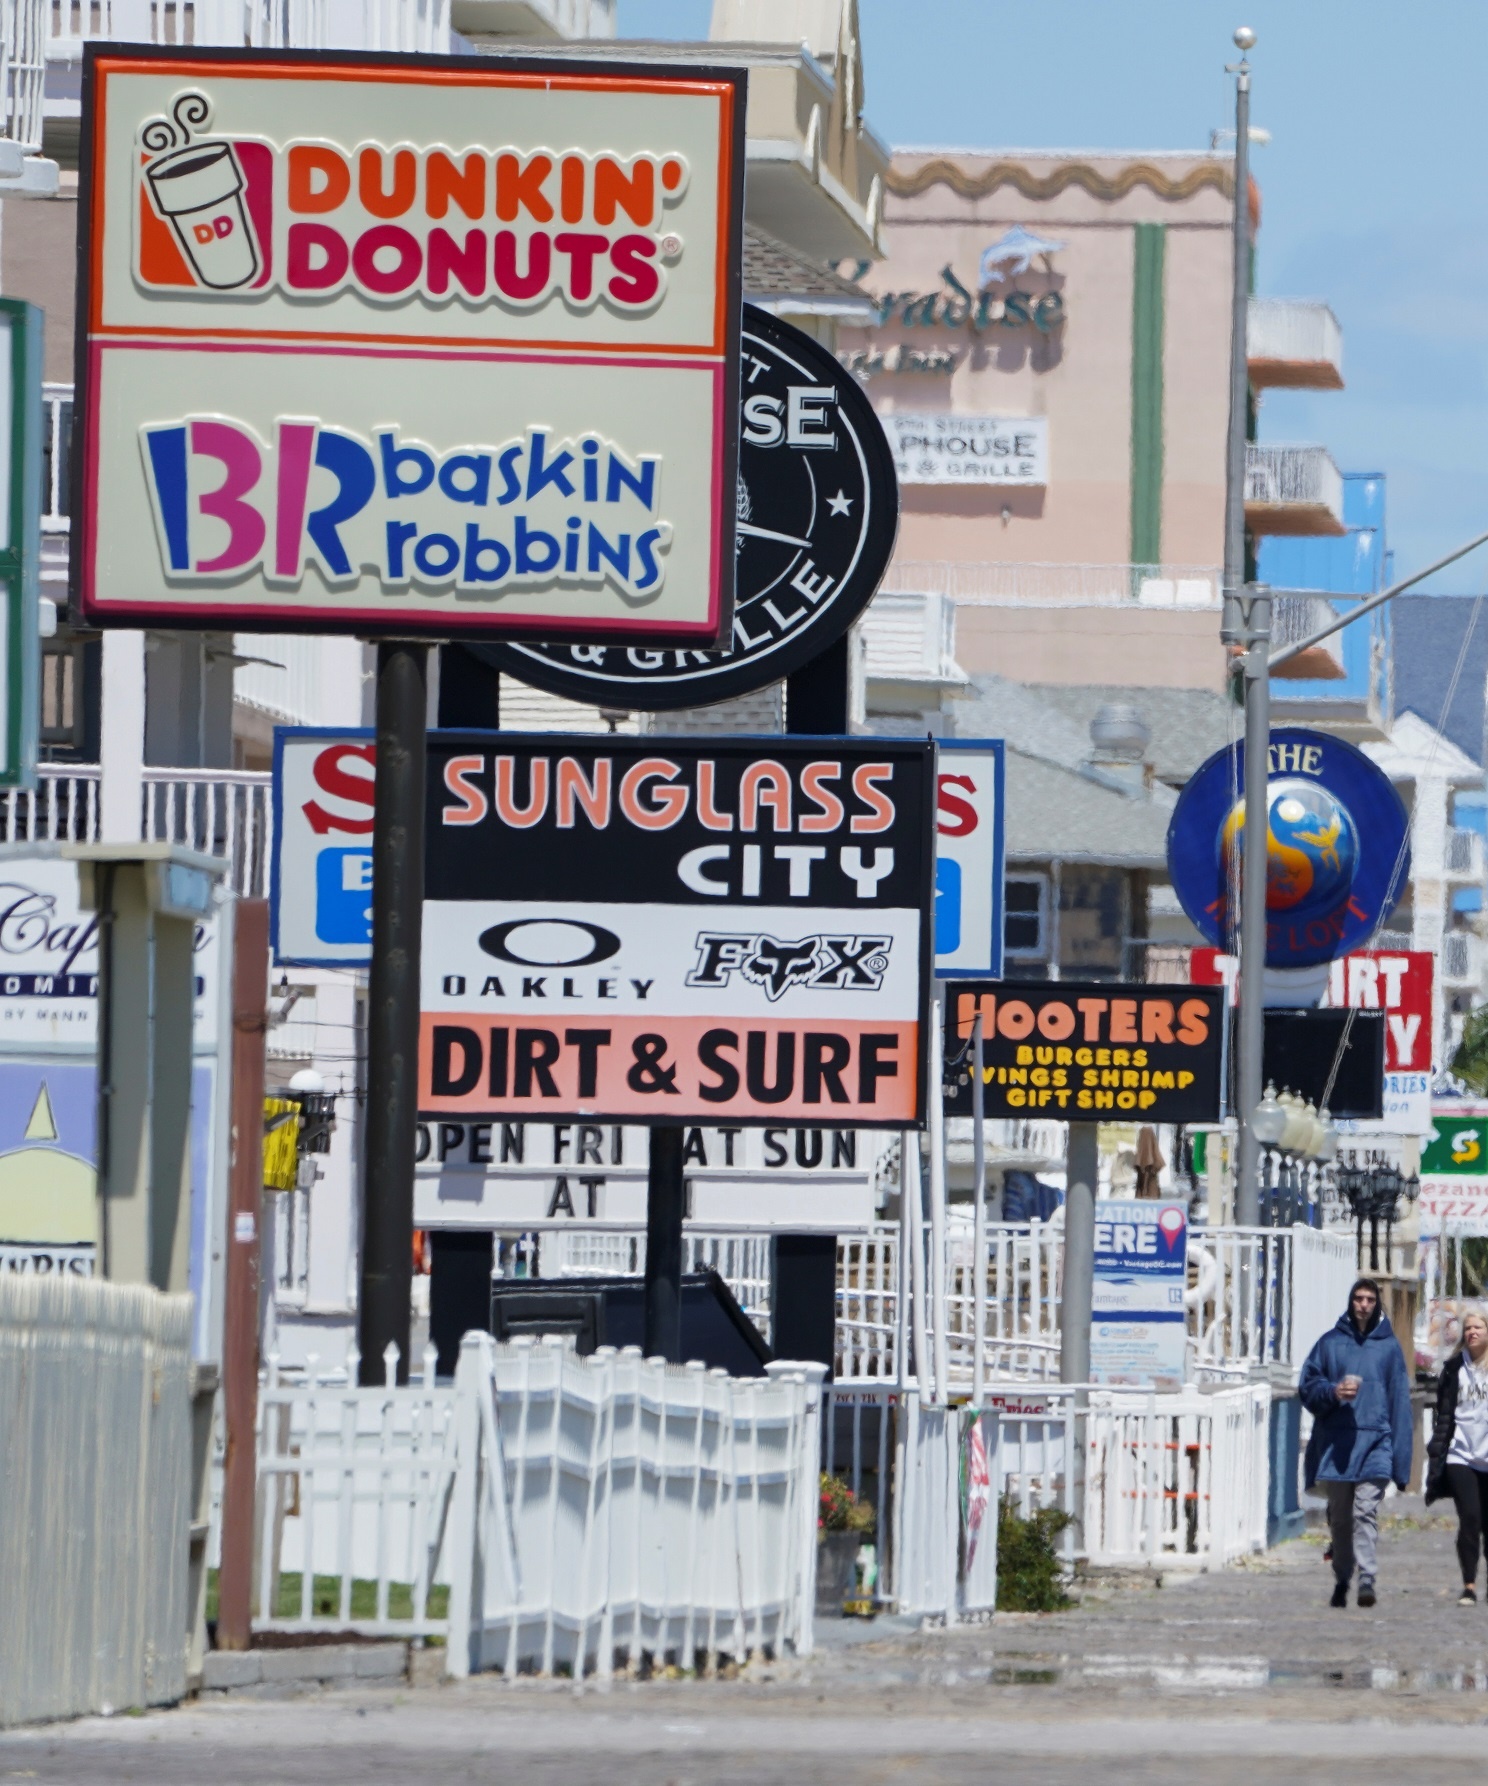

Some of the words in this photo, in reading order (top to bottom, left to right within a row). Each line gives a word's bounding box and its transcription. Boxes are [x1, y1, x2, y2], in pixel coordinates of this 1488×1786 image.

[287, 144, 682, 228] DUNKIN'
[192, 214, 234, 245] DD
[286, 221, 659, 304] DONUTS
[146, 420, 376, 577] BR
[441, 754, 896, 835] SUNGLASS
[677, 843, 895, 899] CITY
[441, 973, 655, 1000] OAKLEY
[957, 992, 1211, 1046] HOOTERS
[430, 1024, 612, 1099] DIRT
[625, 1032, 682, 1095] &
[696, 1027, 900, 1105] SURF
[1016, 1045, 1149, 1067] BURGERS
[1082, 1069, 1195, 1090] SHRIMP
[1006, 1088, 1073, 1109] GIFT
[1076, 1089, 1157, 1110] SHOP
[552, 1124, 624, 1166] FRI
[763, 1128, 857, 1169] SUN
[546, 1175, 606, 1219] AT
